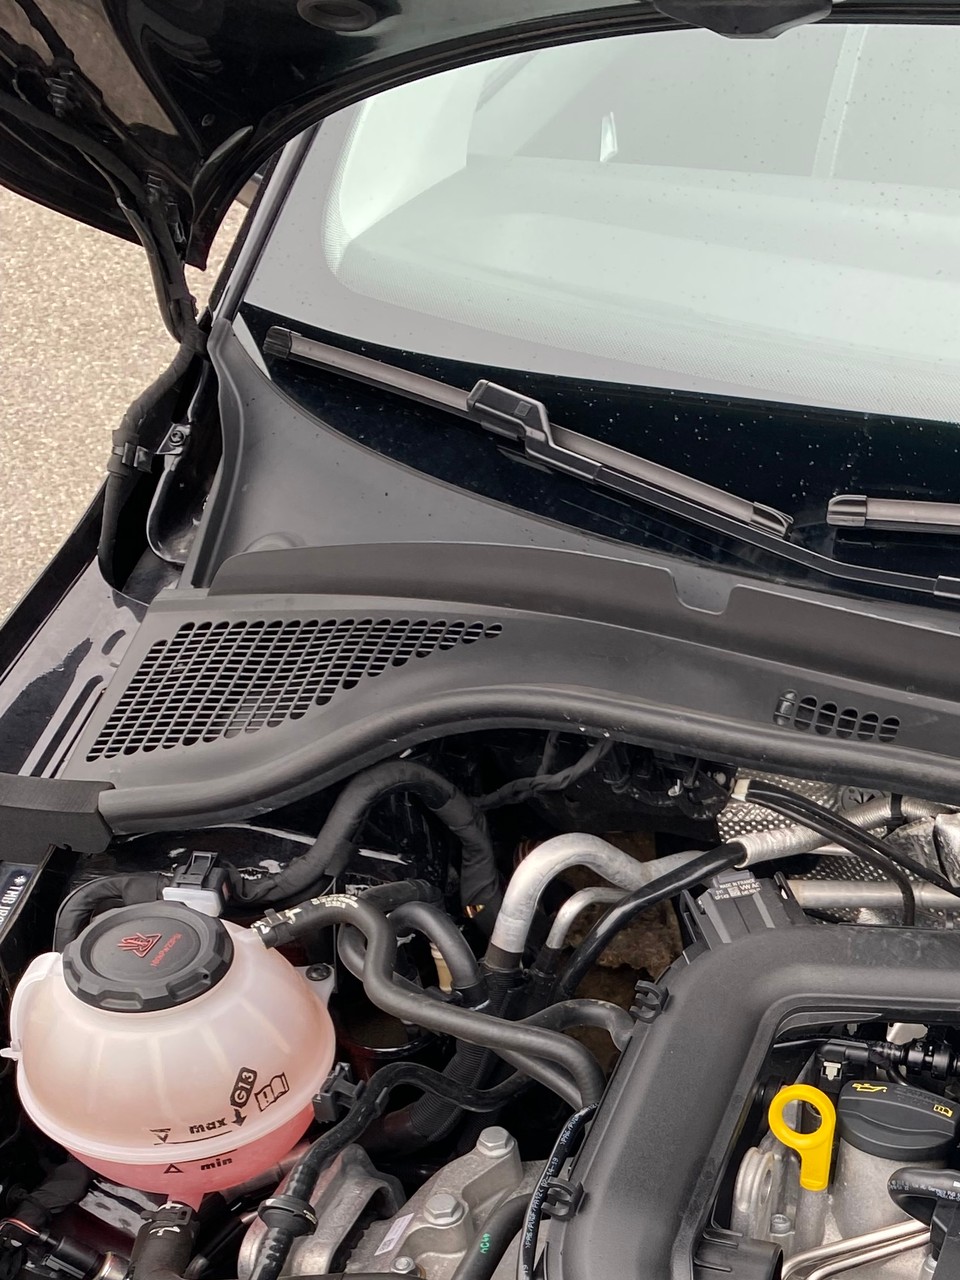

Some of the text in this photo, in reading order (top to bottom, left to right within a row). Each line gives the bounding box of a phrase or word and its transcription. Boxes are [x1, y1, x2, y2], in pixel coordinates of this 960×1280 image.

[234, 1071, 254, 1104] G13
[189, 1118, 228, 1134] max
[200, 1158, 233, 1171] min
